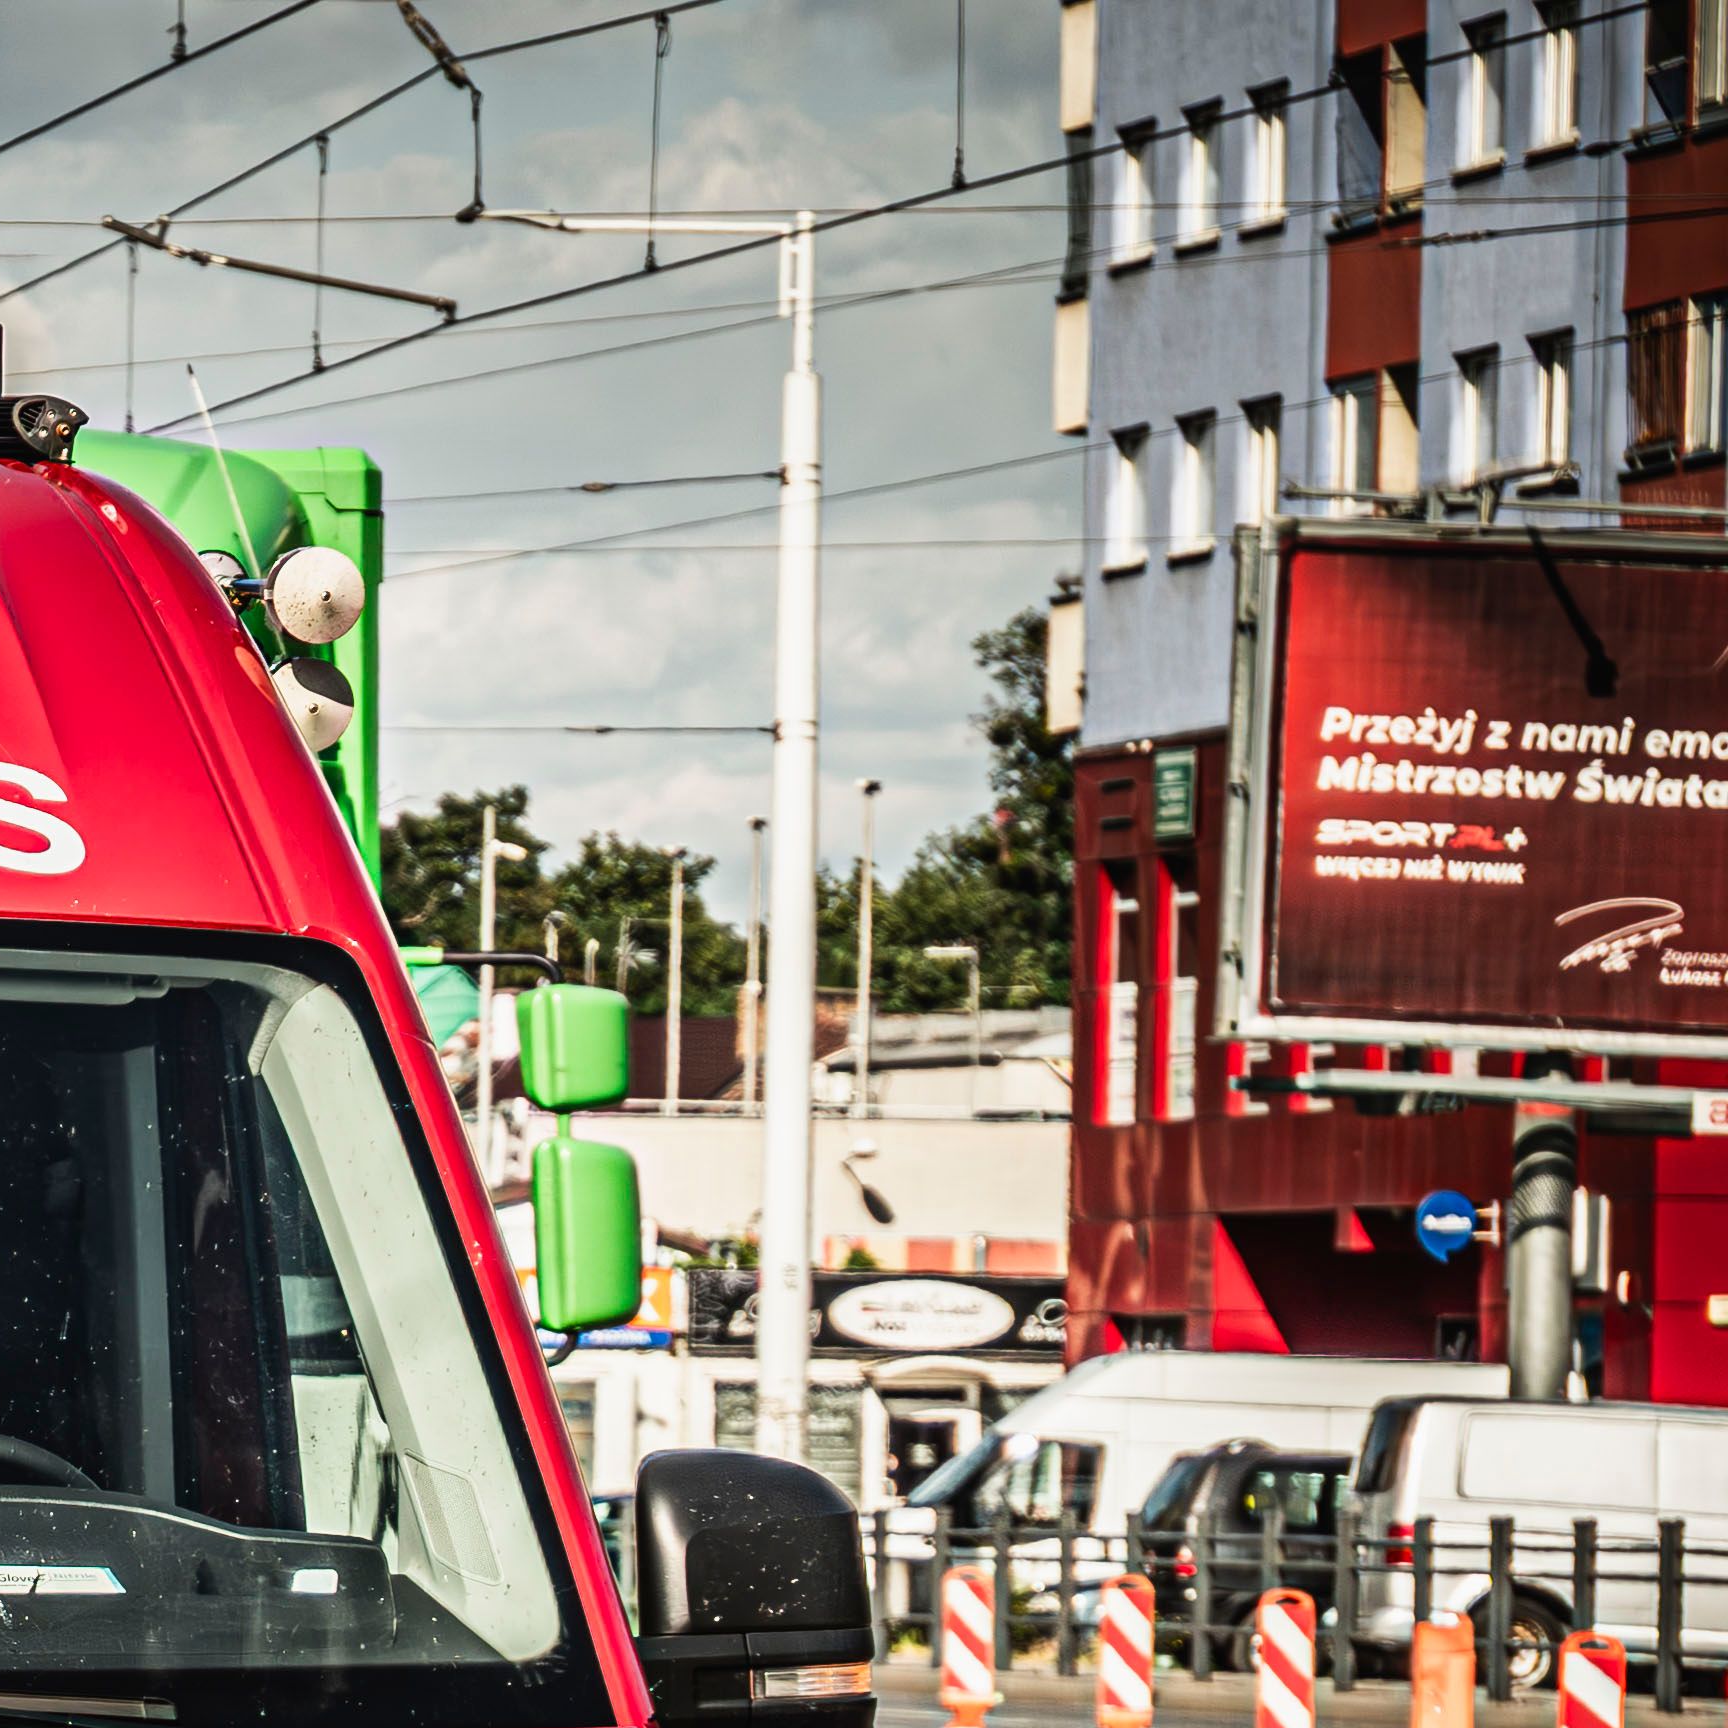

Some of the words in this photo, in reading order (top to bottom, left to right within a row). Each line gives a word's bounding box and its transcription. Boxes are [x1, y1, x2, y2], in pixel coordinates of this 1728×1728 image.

[1320, 706, 1478, 755] Przeżyj
[1484, 719, 1512, 750] z
[1520, 717, 1635, 755] nami
[1318, 753, 1566, 800] Mistrzostw
[1573, 759, 1728, 810] Świata
[1315, 856, 1401, 882] WIĘCEJ
[1404, 854, 1444, 880] NIŻ
[1448, 861, 1527, 885] WYNIK
